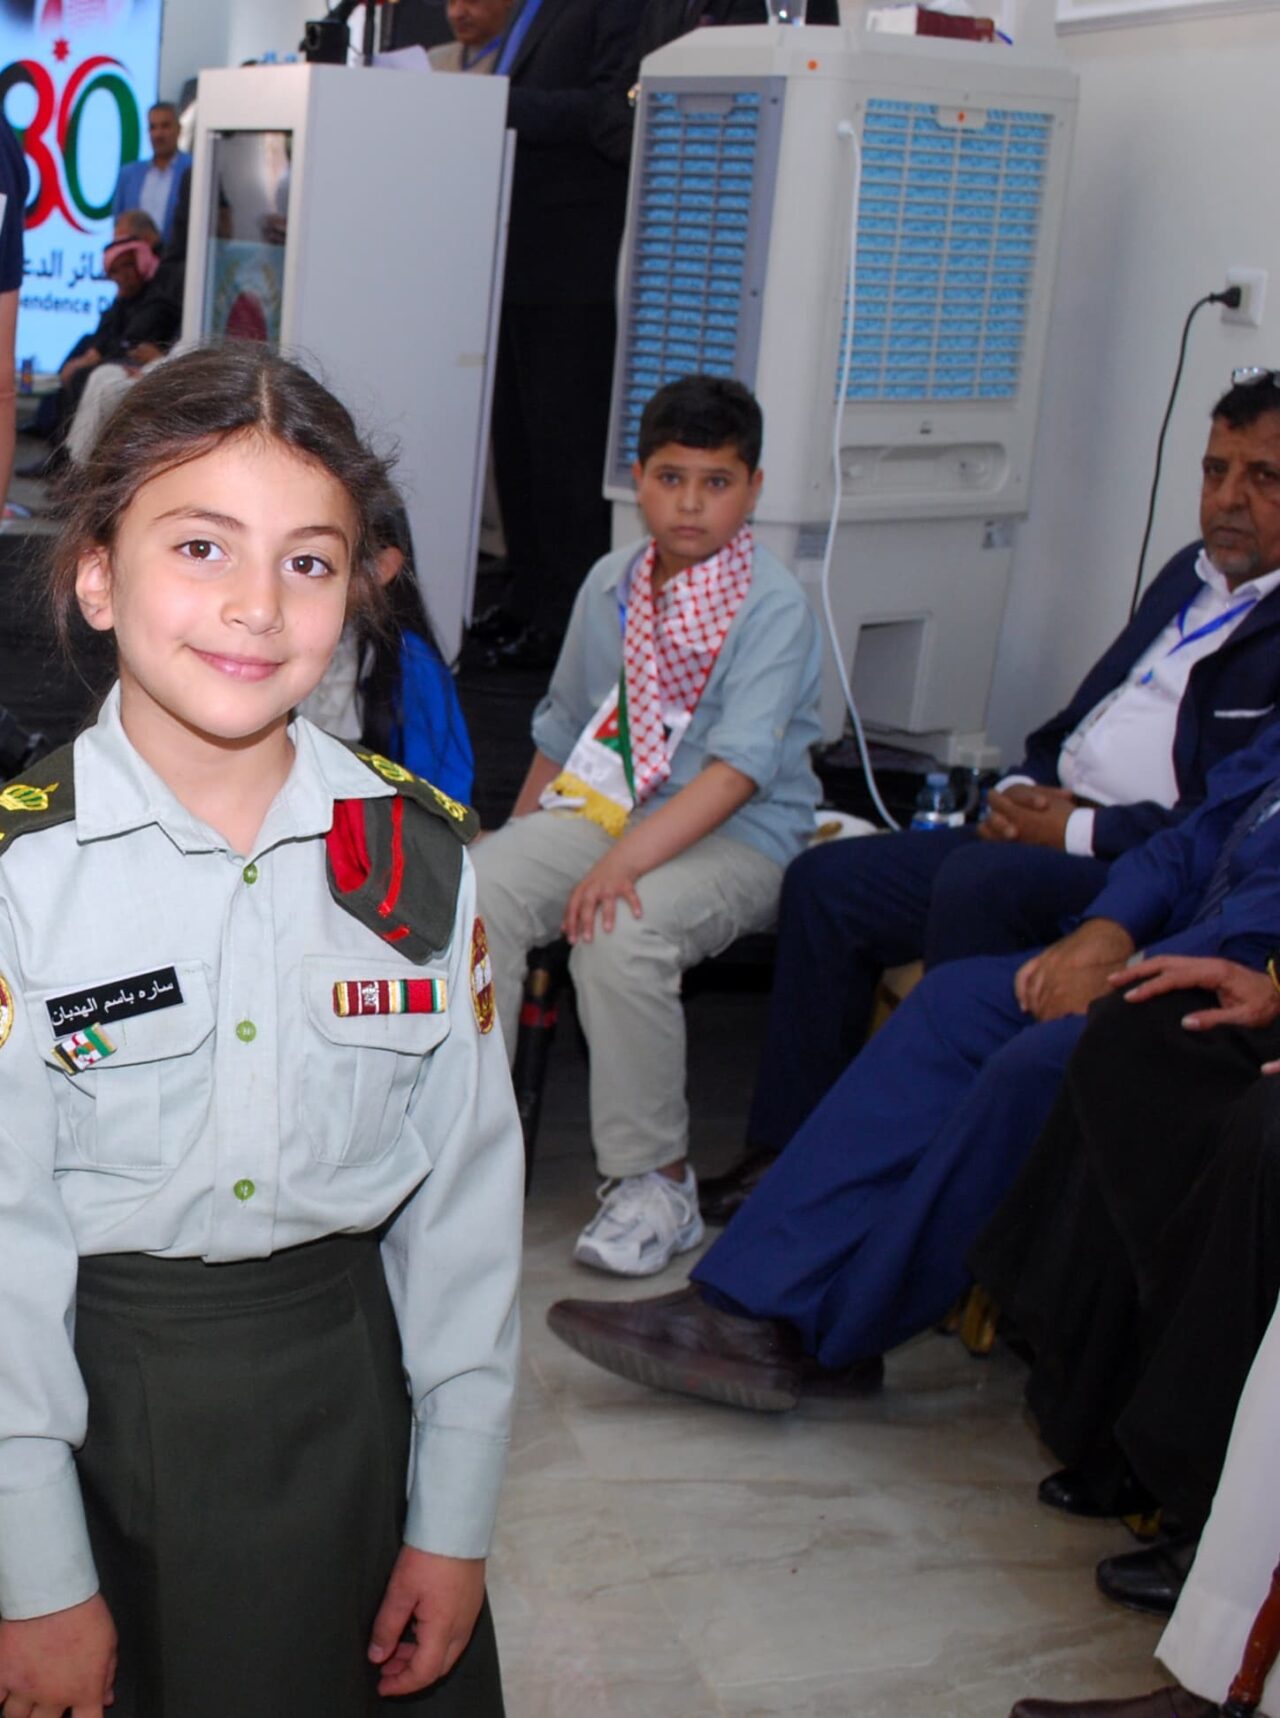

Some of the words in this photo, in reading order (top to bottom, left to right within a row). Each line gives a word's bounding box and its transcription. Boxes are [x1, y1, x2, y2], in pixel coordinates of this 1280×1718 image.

[21, 294, 90, 313] endence
[138, 980, 173, 1000] ساره
[104, 990, 135, 1014] باسم
